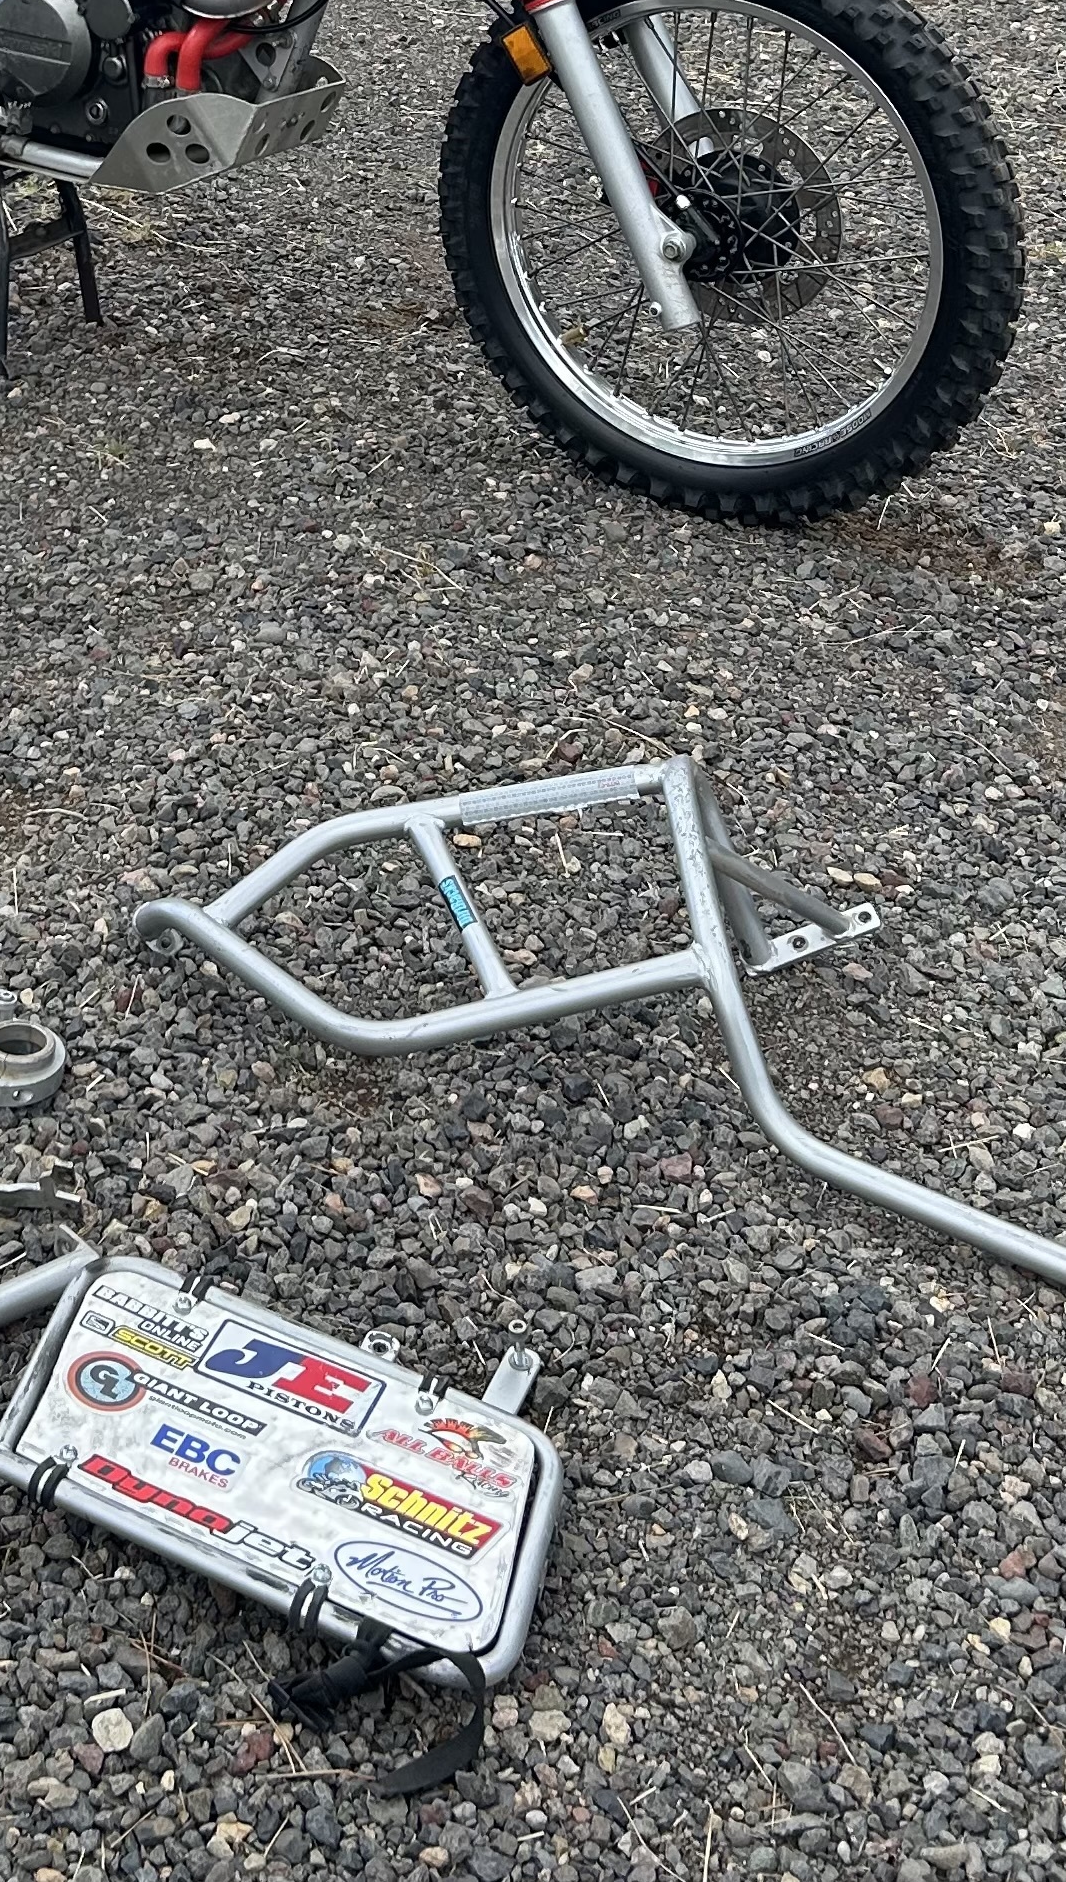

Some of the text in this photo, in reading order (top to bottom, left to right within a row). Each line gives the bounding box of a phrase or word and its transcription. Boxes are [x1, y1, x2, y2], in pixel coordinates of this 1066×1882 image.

[92, 1284, 210, 1342] BABBITT'S
[138, 1319, 204, 1353] ONLINE
[112, 1326, 196, 1370] SCOTT
[133, 1372, 260, 1431] GIANT LOOP
[205, 1338, 372, 1414] JE
[246, 1380, 356, 1431] PISTONS
[150, 1423, 241, 1476] EBC
[168, 1456, 229, 1488] BRAKES
[375, 1428, 518, 1489] ALL BALLS
[360, 1473, 494, 1547] Schnitz
[360, 1503, 474, 1557] RACING
[346, 1550, 464, 1605] Motion Pro
